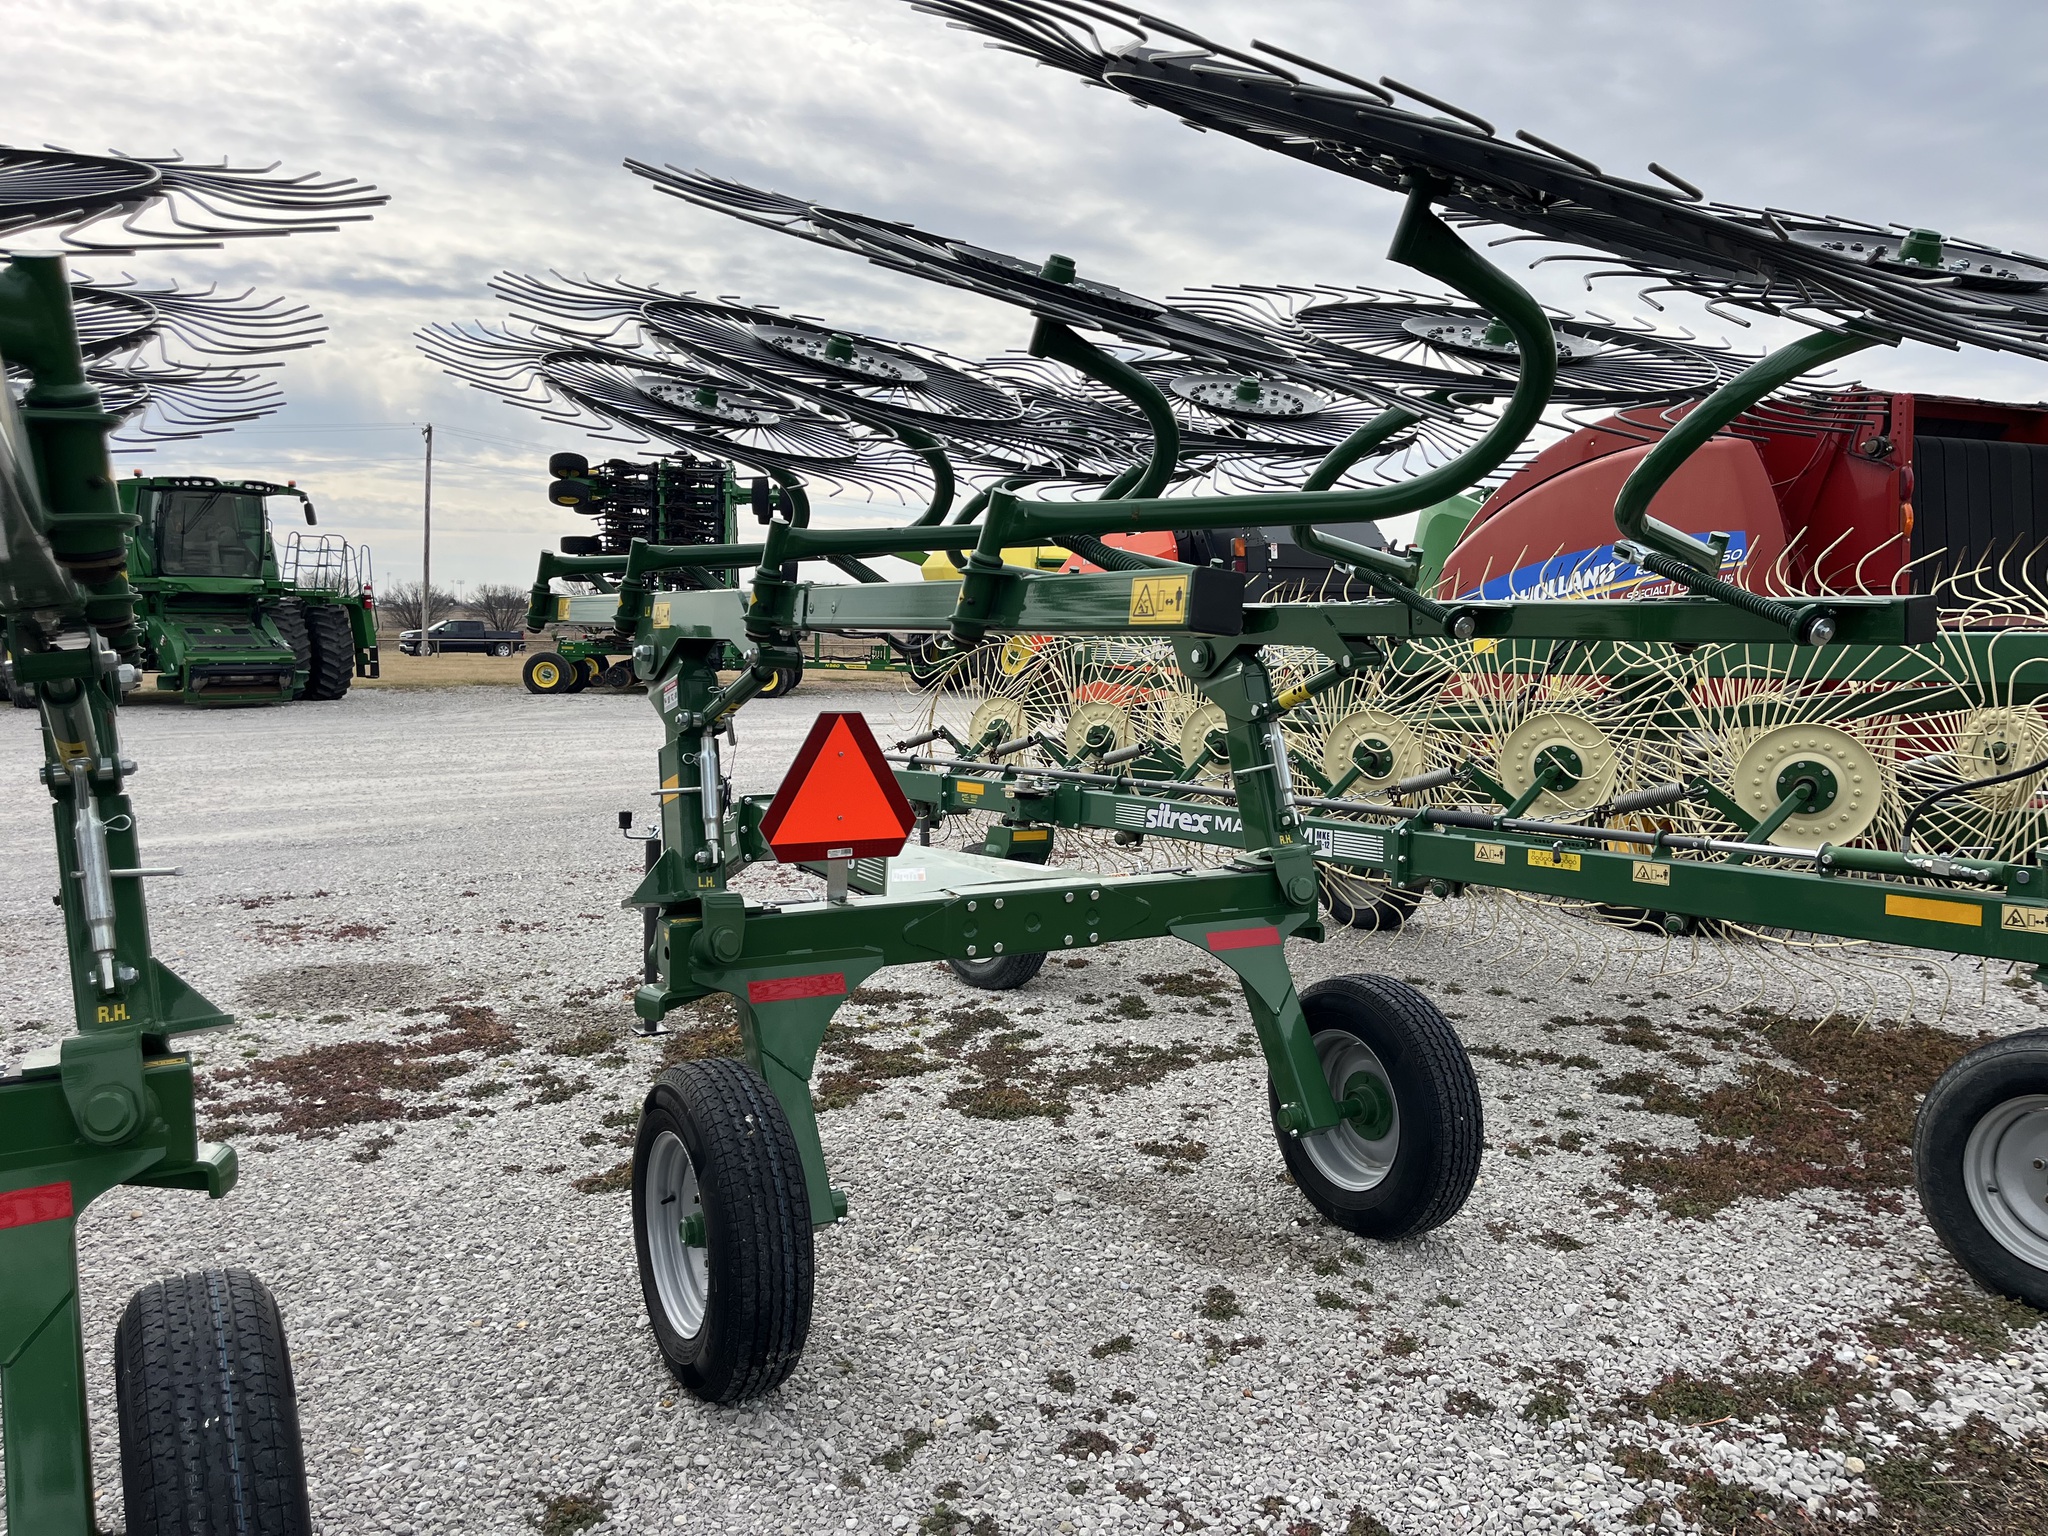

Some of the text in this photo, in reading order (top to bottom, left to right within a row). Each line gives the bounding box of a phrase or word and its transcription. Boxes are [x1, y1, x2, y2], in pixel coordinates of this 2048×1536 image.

[1145, 802, 1213, 834] sitrex
[1279, 834, 1293, 845] R.H.
[697, 875, 716, 888] L.H.
[97, 1003, 131, 1024] R.H.
